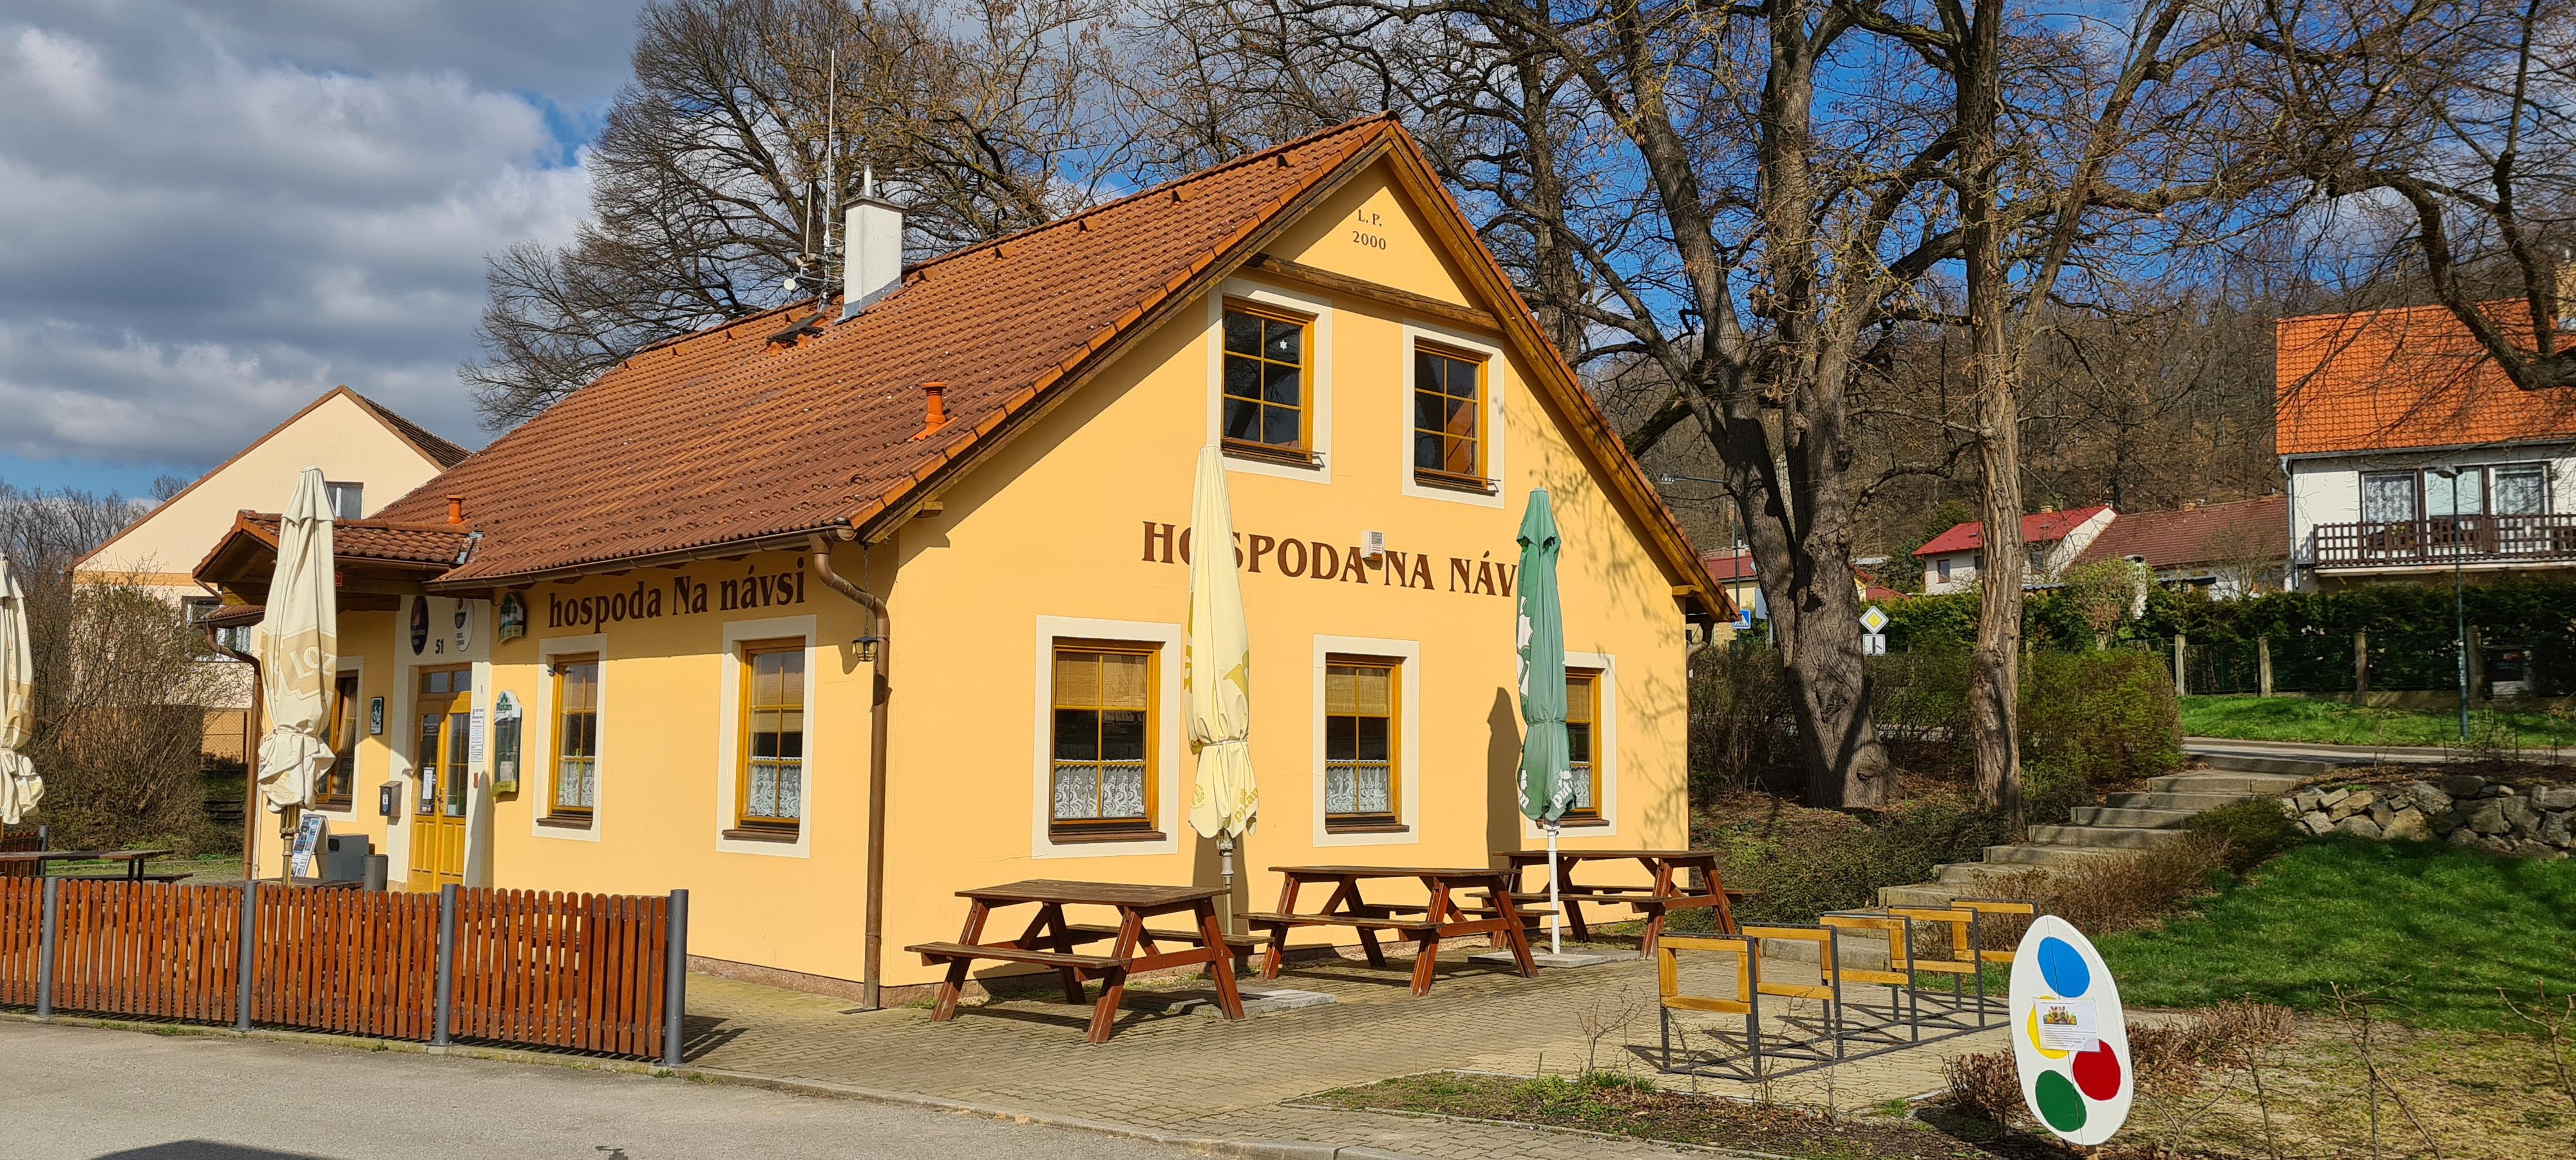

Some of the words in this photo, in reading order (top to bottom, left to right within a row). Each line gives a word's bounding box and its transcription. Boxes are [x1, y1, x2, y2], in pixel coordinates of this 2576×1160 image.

[1358, 209, 1368, 223] L.
[1372, 213, 1382, 227] P.
[1352, 231, 1386, 251] 2000
[1384, 550, 1435, 591] NA
[1449, 550, 1517, 598] NÁV
[548, 580, 662, 634] hospoda
[672, 575, 708, 616] Na
[719, 556, 805, 611] návsi
[435, 638, 444, 654] 51
